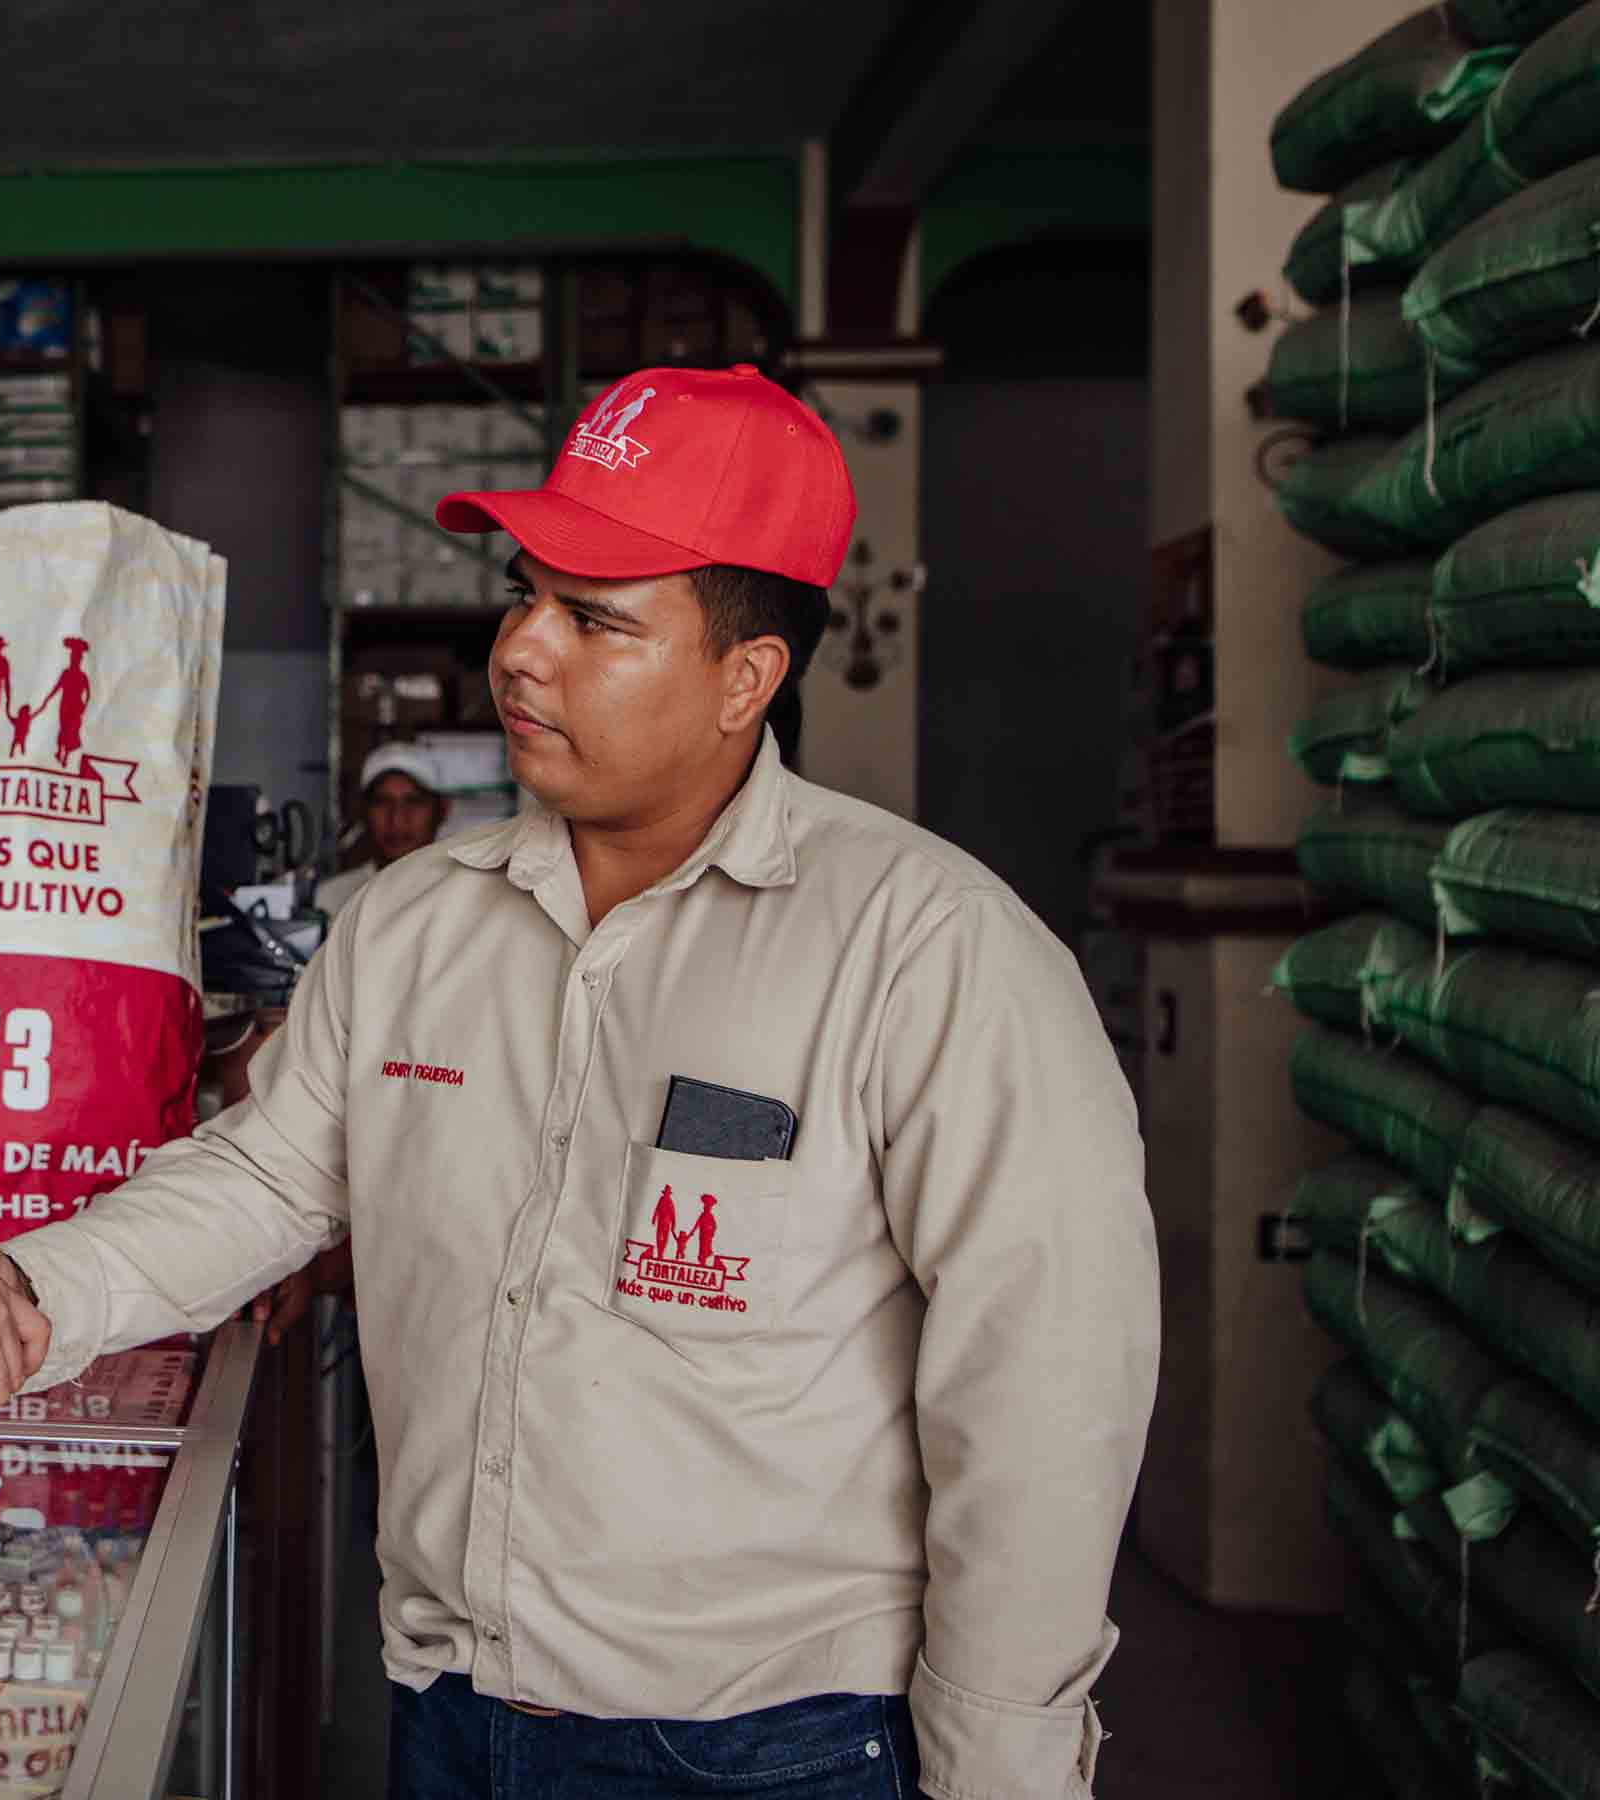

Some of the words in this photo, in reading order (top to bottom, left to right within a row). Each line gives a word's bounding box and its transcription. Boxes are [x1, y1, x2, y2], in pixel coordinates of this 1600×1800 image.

[28, 838, 100, 873] QUE
[382, 1061, 413, 1078] HENRY
[414, 1063, 464, 1086] FIGUEROA
[3, 1140, 51, 1172] DE
[644, 1262, 718, 1287] FORTALEZA
[616, 1277, 643, 1297] Más
[648, 1286, 674, 1303] que
[677, 1290, 696, 1306] un
[699, 1293, 747, 1313] cultivo
